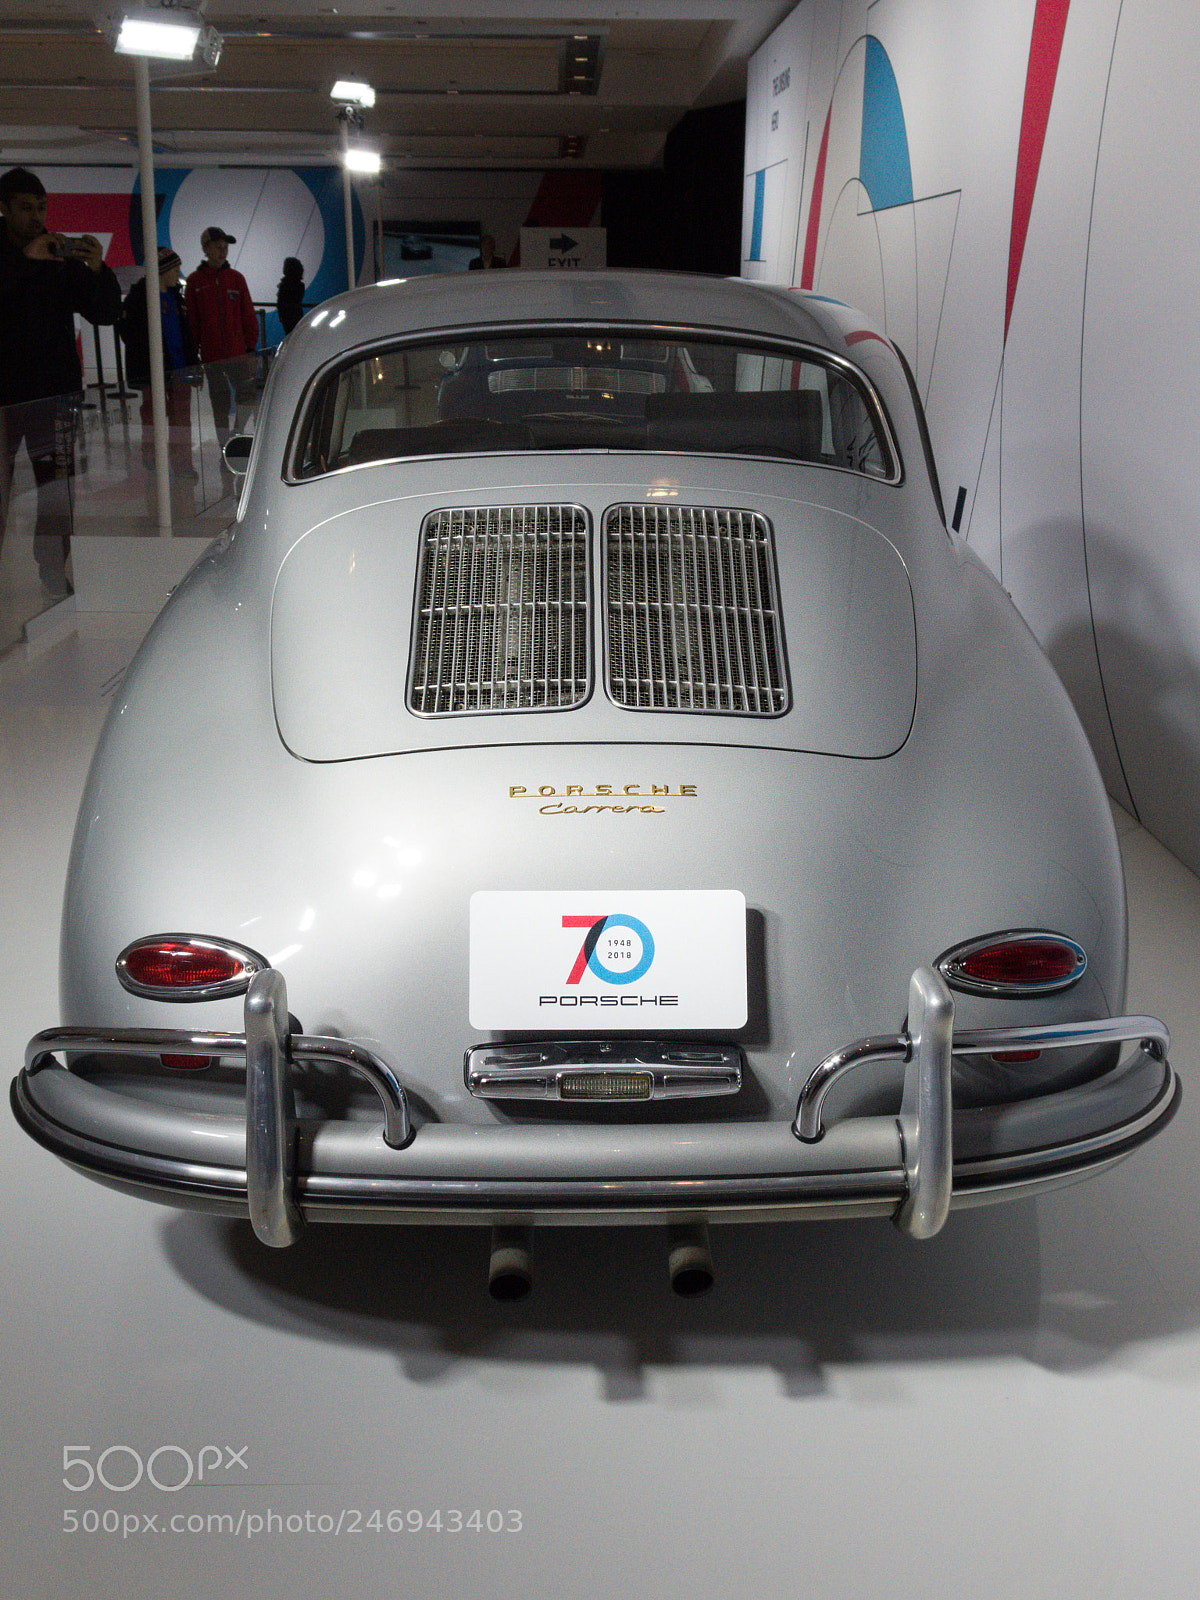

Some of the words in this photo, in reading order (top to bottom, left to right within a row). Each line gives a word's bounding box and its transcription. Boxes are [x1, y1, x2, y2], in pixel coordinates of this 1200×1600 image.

[548, 257, 581, 268] EXIT
[509, 784, 698, 798] PORSCHE
[538, 802, 666, 816] Carrera
[607, 939, 632, 947] 1948
[561, 913, 656, 986] 70
[607, 951, 632, 959] 2018
[538, 995, 679, 1007] PORSCHE
